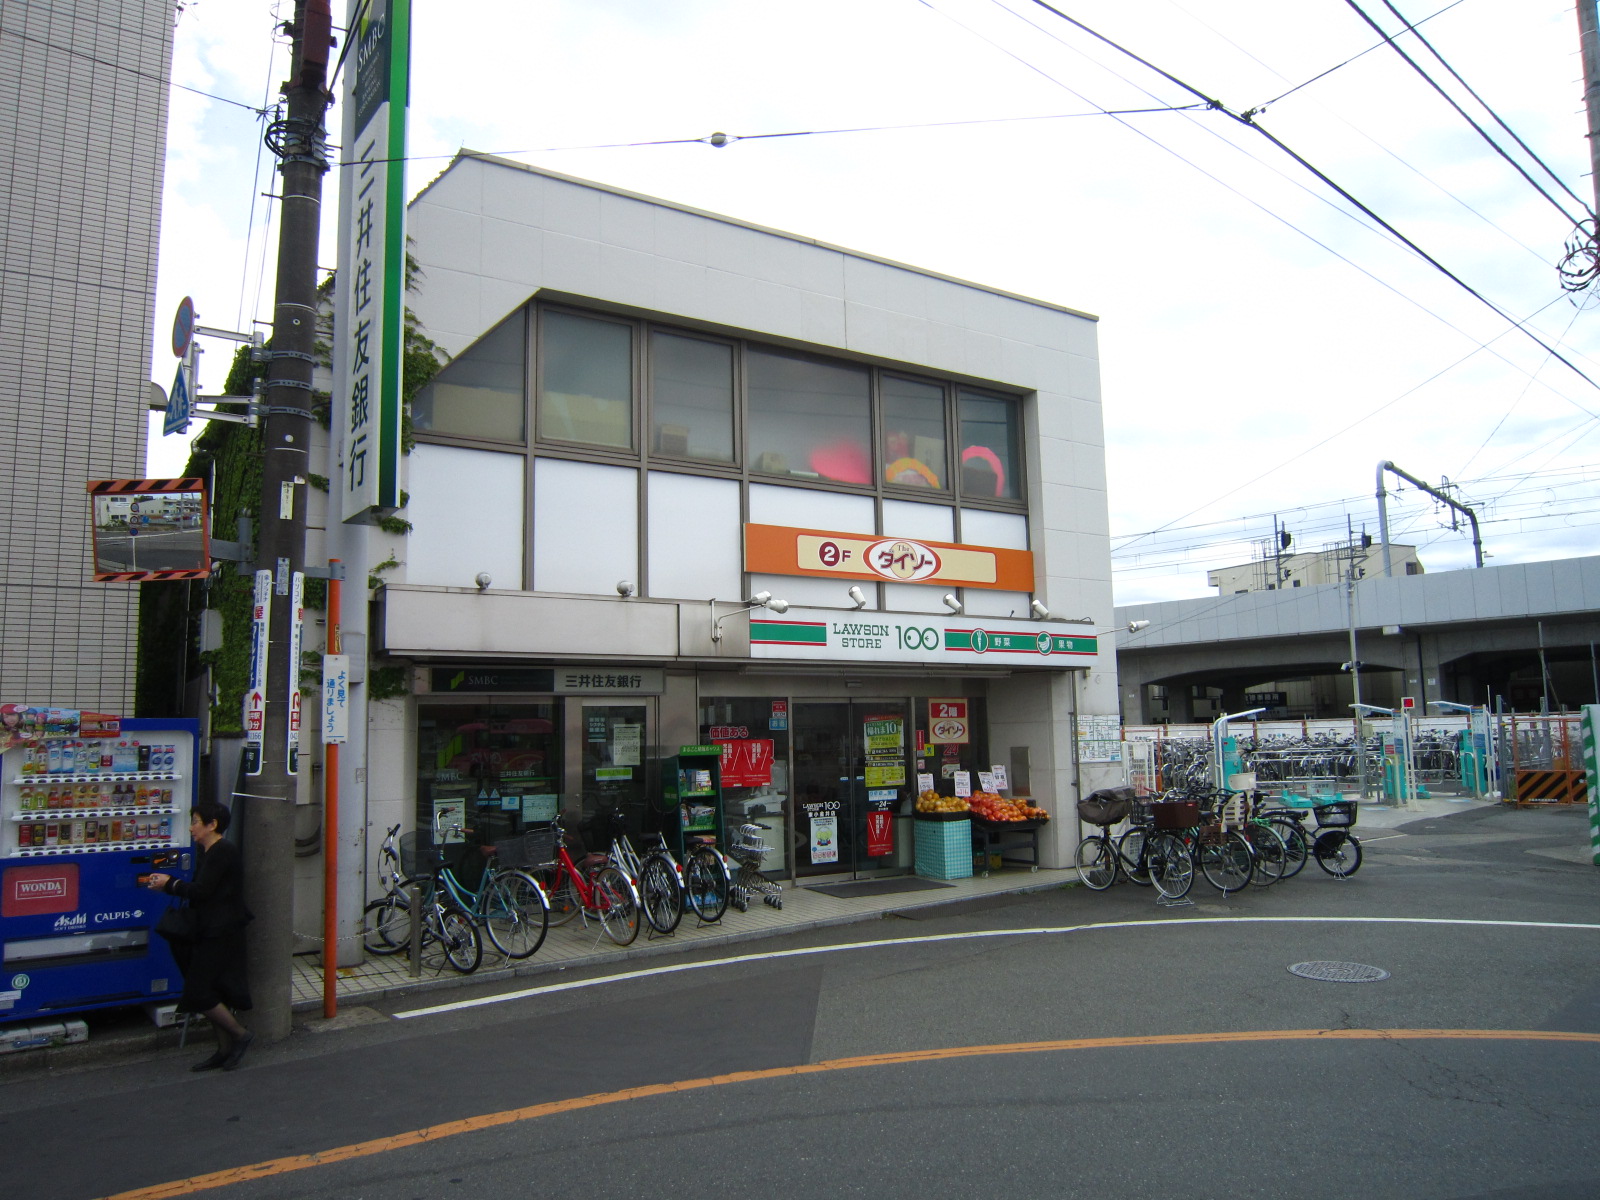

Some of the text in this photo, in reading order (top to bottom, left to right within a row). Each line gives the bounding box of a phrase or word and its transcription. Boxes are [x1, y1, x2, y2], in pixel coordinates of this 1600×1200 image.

[358, 12, 386, 73] SMBC
[348, 138, 376, 493] 三井住友銀行
[878, 548, 933, 572] ダイソー
[833, 622, 890, 637] LAWSON
[841, 637, 883, 649] STORE
[895, 625, 940, 651] 100
[994, 636, 1011, 647] 野菜
[1058, 639, 1074, 649] 果物
[468, 675, 498, 686] SMBC
[565, 674, 641, 688] 三井住友銀行
[337, 670, 346, 708] よく見て
[326, 678, 336, 733] 通りましょう
[939, 703, 958, 718] 2階
[709, 726, 749, 739] 価値ある
[436, 772, 464, 781] SMBC
[500, 769, 535, 777] 三井住友銀行
[824, 800, 841, 811] 100
[878, 800, 887, 808] 24
[21, 880, 62, 893] WONDA
[54, 912, 87, 927] Asahi
[94, 910, 131, 923] CALPIS
